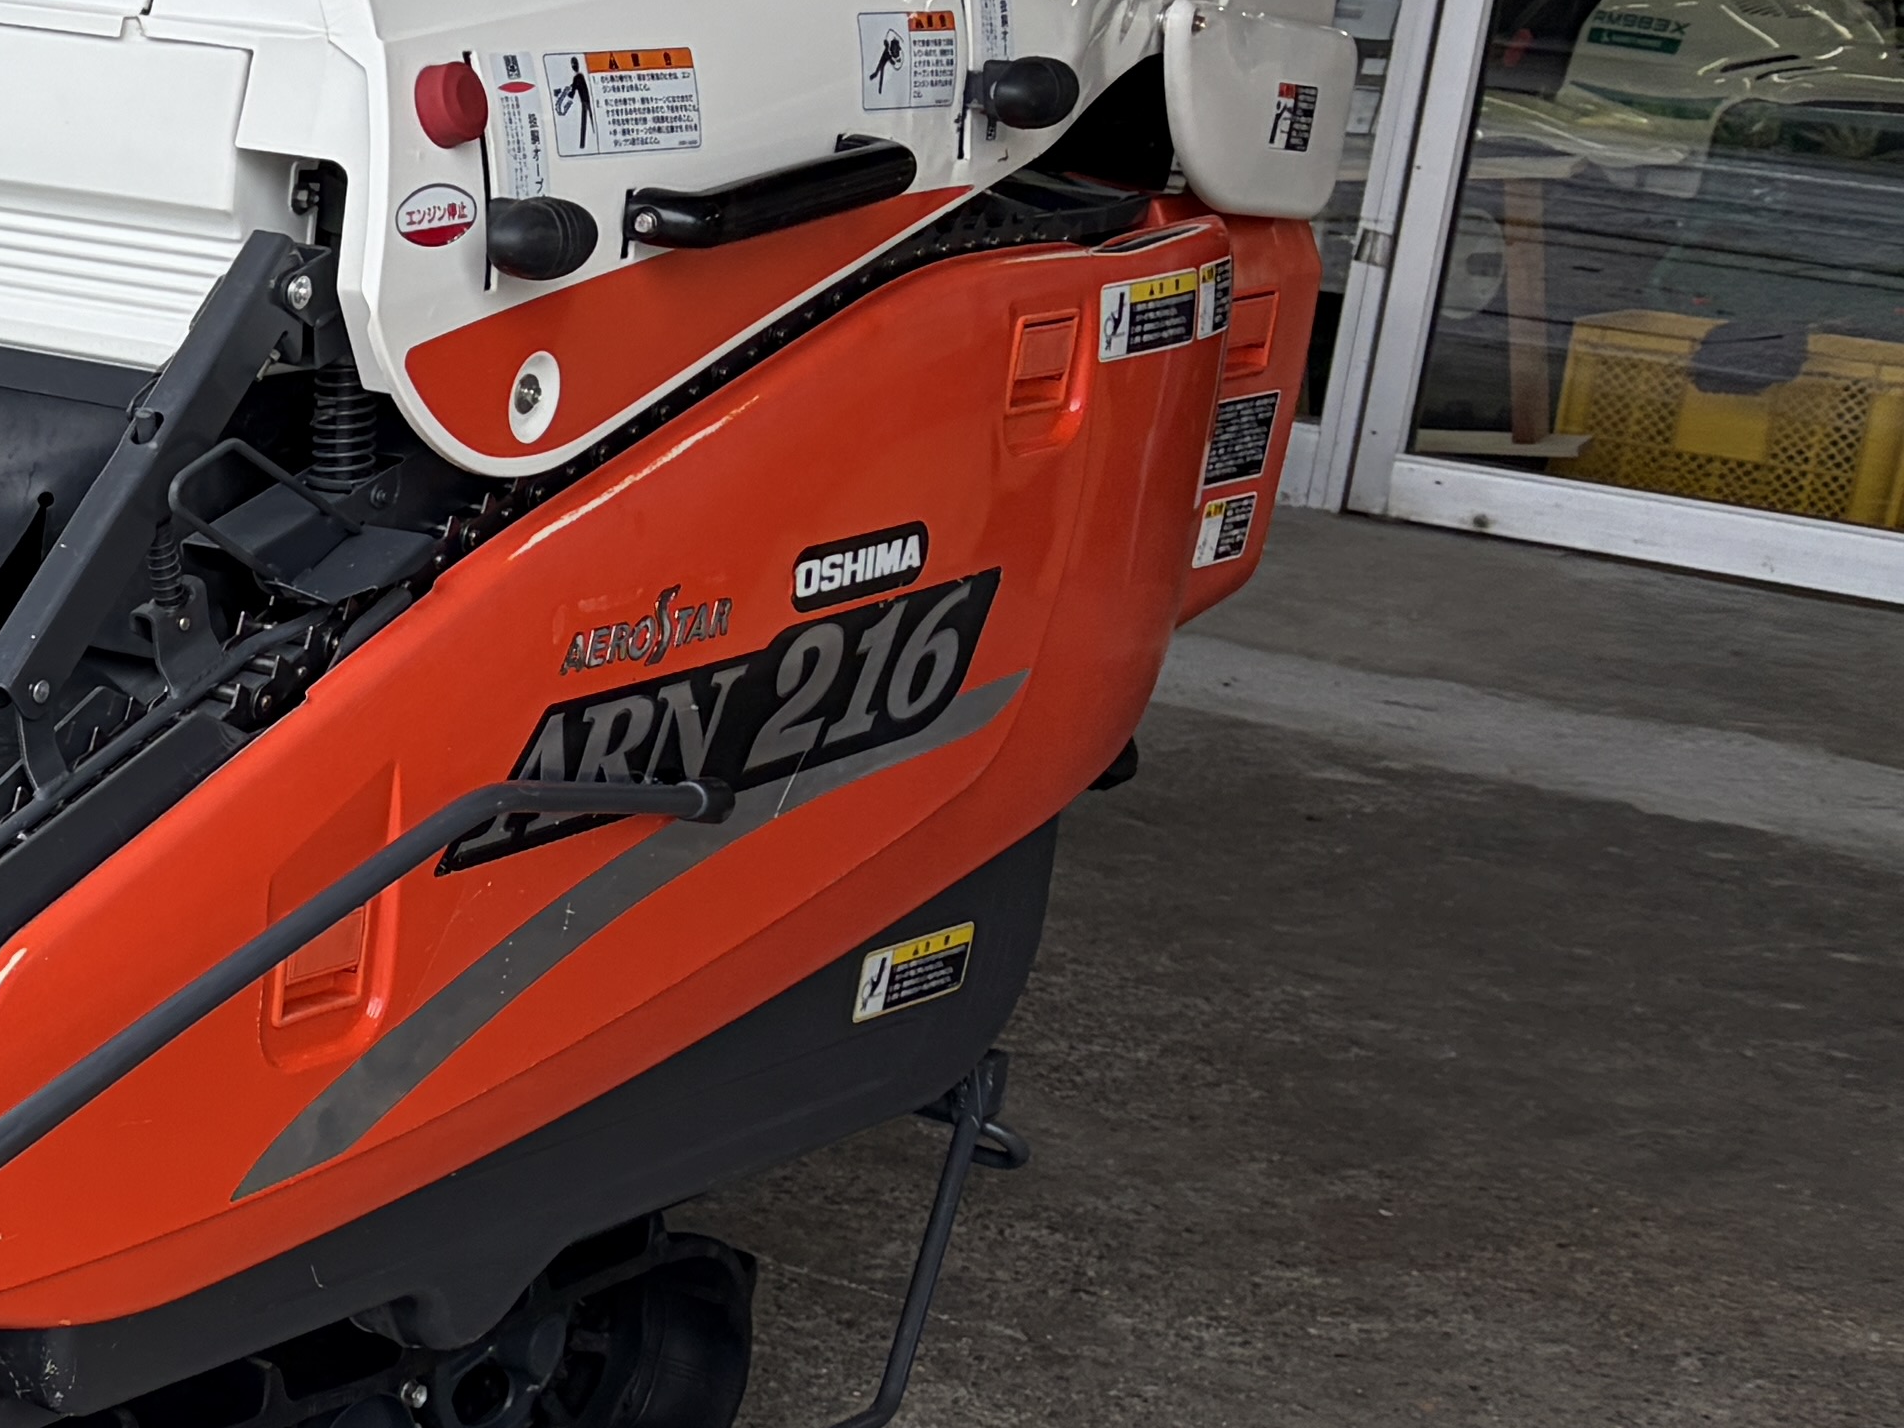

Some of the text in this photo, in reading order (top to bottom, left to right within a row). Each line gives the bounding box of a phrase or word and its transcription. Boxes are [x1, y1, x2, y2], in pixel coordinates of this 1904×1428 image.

[405, 201, 468, 226] エンジン停止
[795, 534, 921, 599] OSHIMA
[560, 584, 733, 676] AEROSTAR
[456, 584, 973, 857] ARN 216
